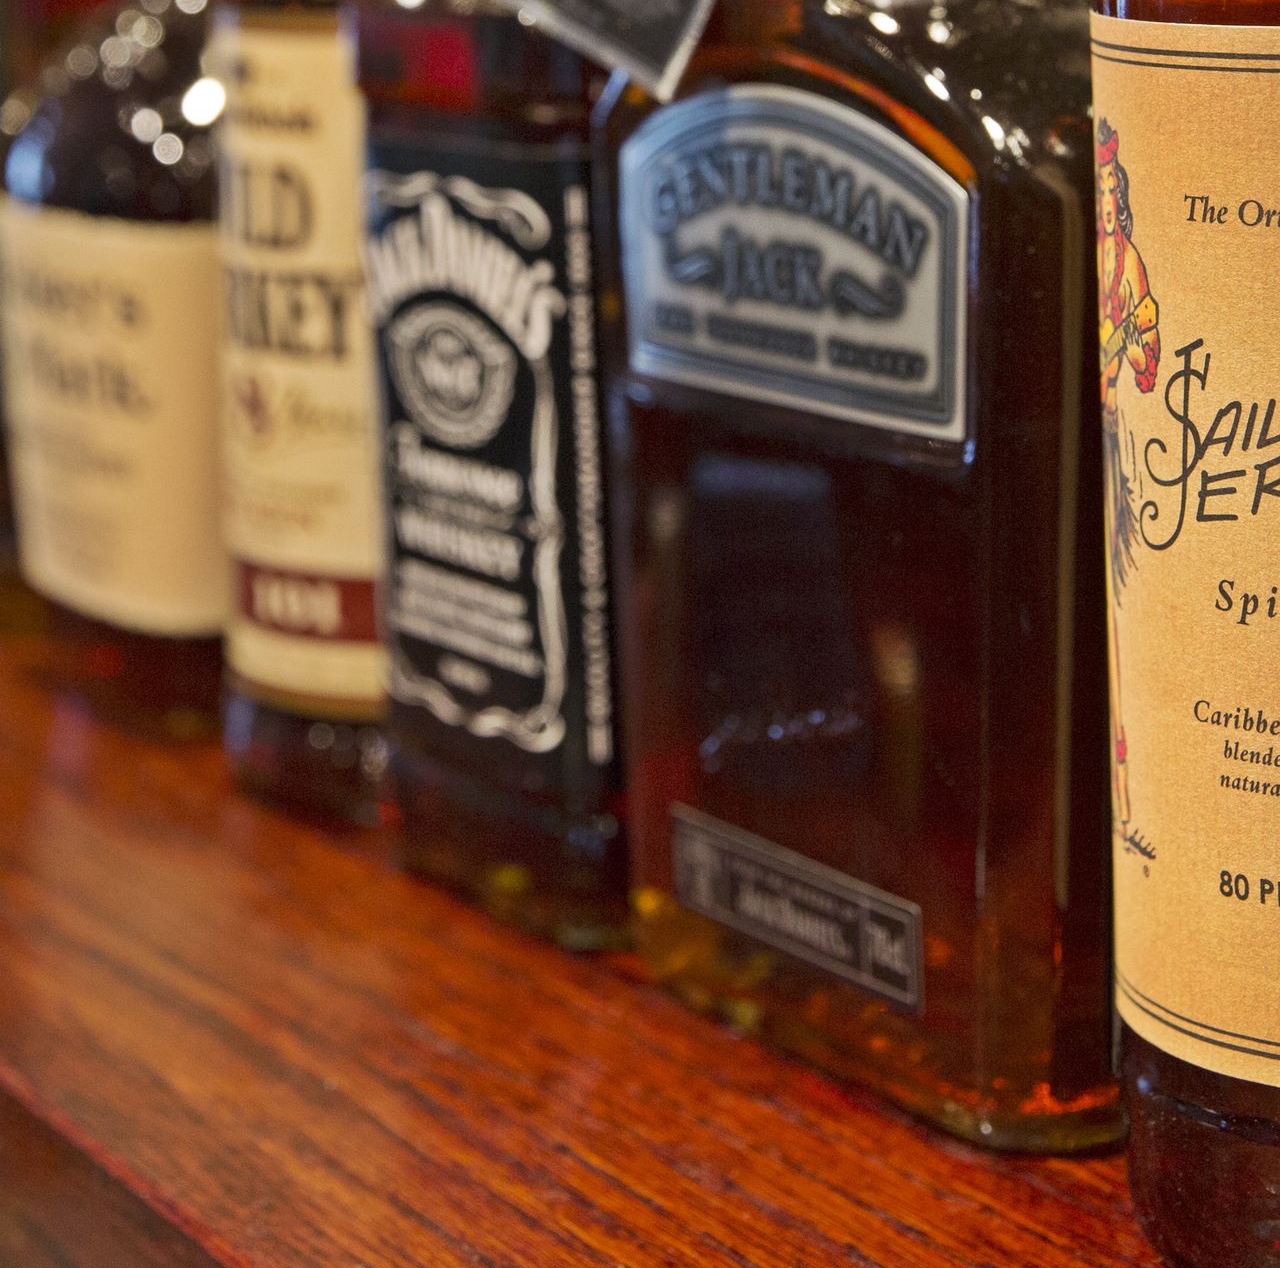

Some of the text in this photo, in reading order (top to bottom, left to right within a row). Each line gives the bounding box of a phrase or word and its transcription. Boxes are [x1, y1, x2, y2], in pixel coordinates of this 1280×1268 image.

[657, 142, 927, 278] GENTLEMAN
[1184, 193, 1229, 226] The
[722, 229, 828, 308] JACK
[1218, 869, 1250, 902] 80
